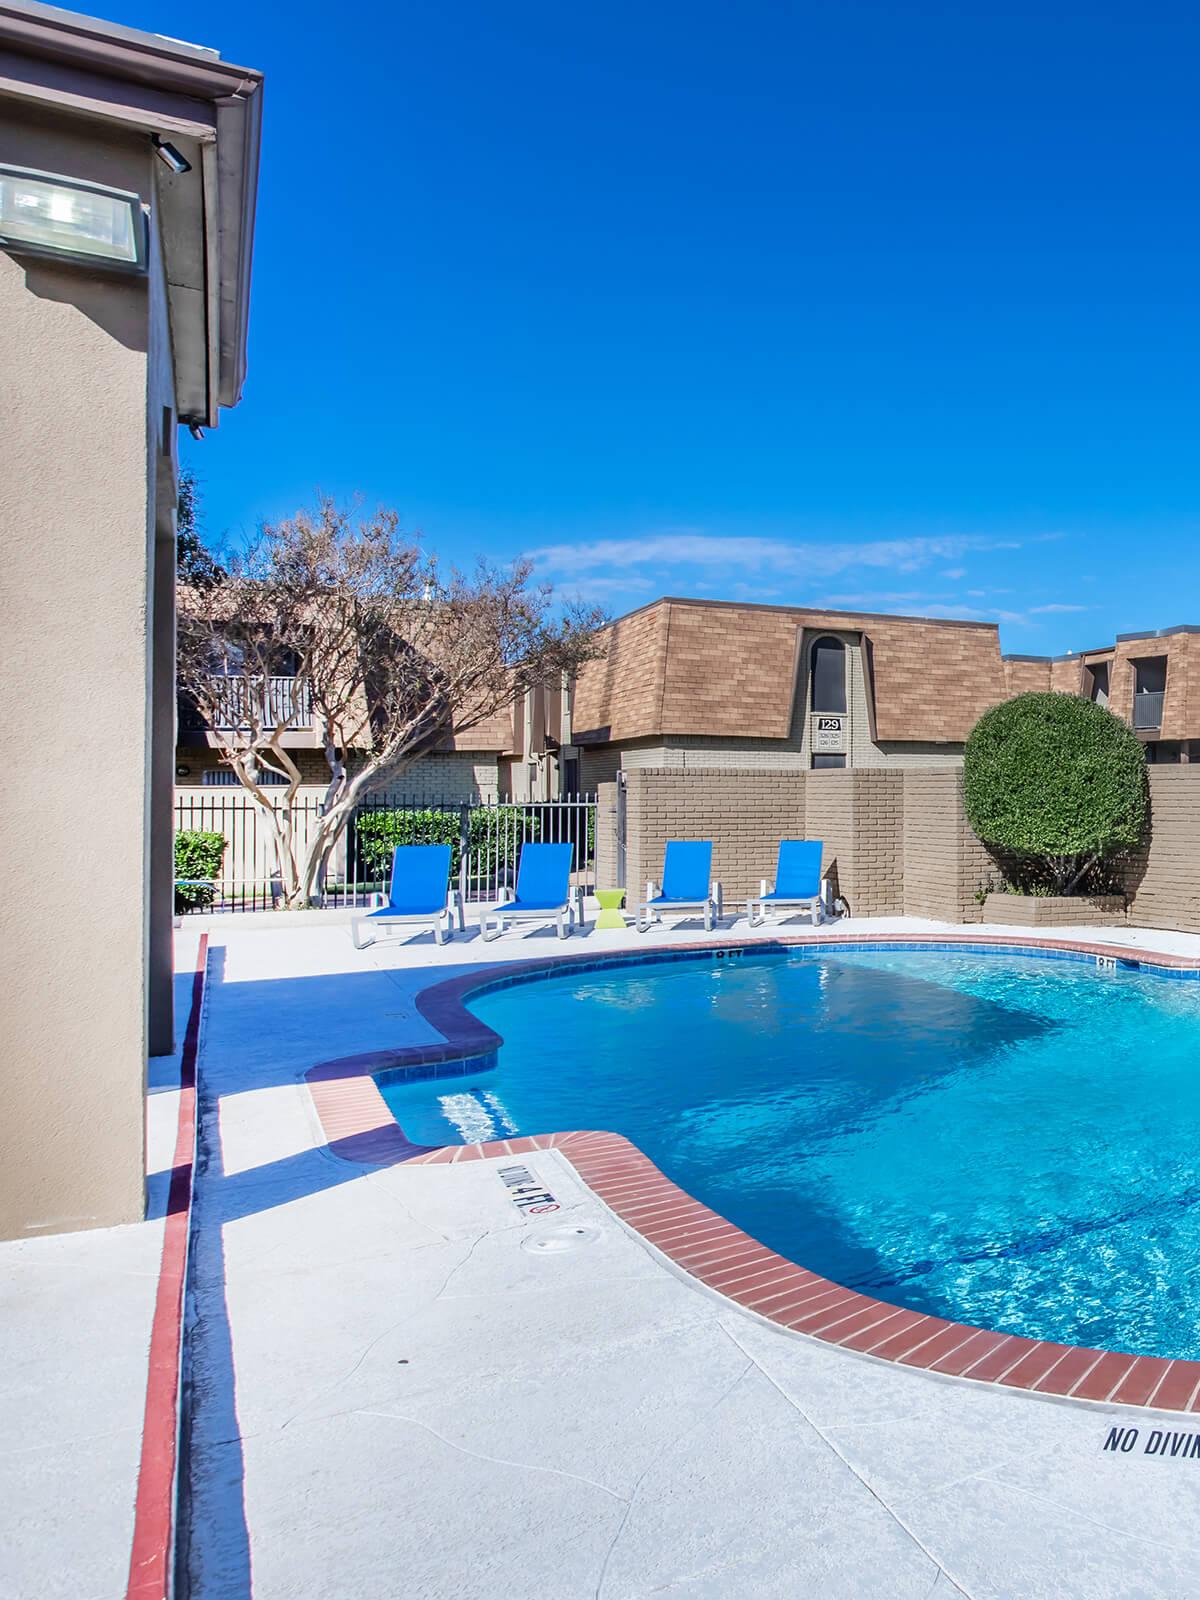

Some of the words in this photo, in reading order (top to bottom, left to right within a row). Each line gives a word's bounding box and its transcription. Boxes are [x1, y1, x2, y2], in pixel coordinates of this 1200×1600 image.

[821, 719, 839, 730] 129
[511, 1187, 544, 1195] 4
[1103, 1427, 1139, 1453] NO
